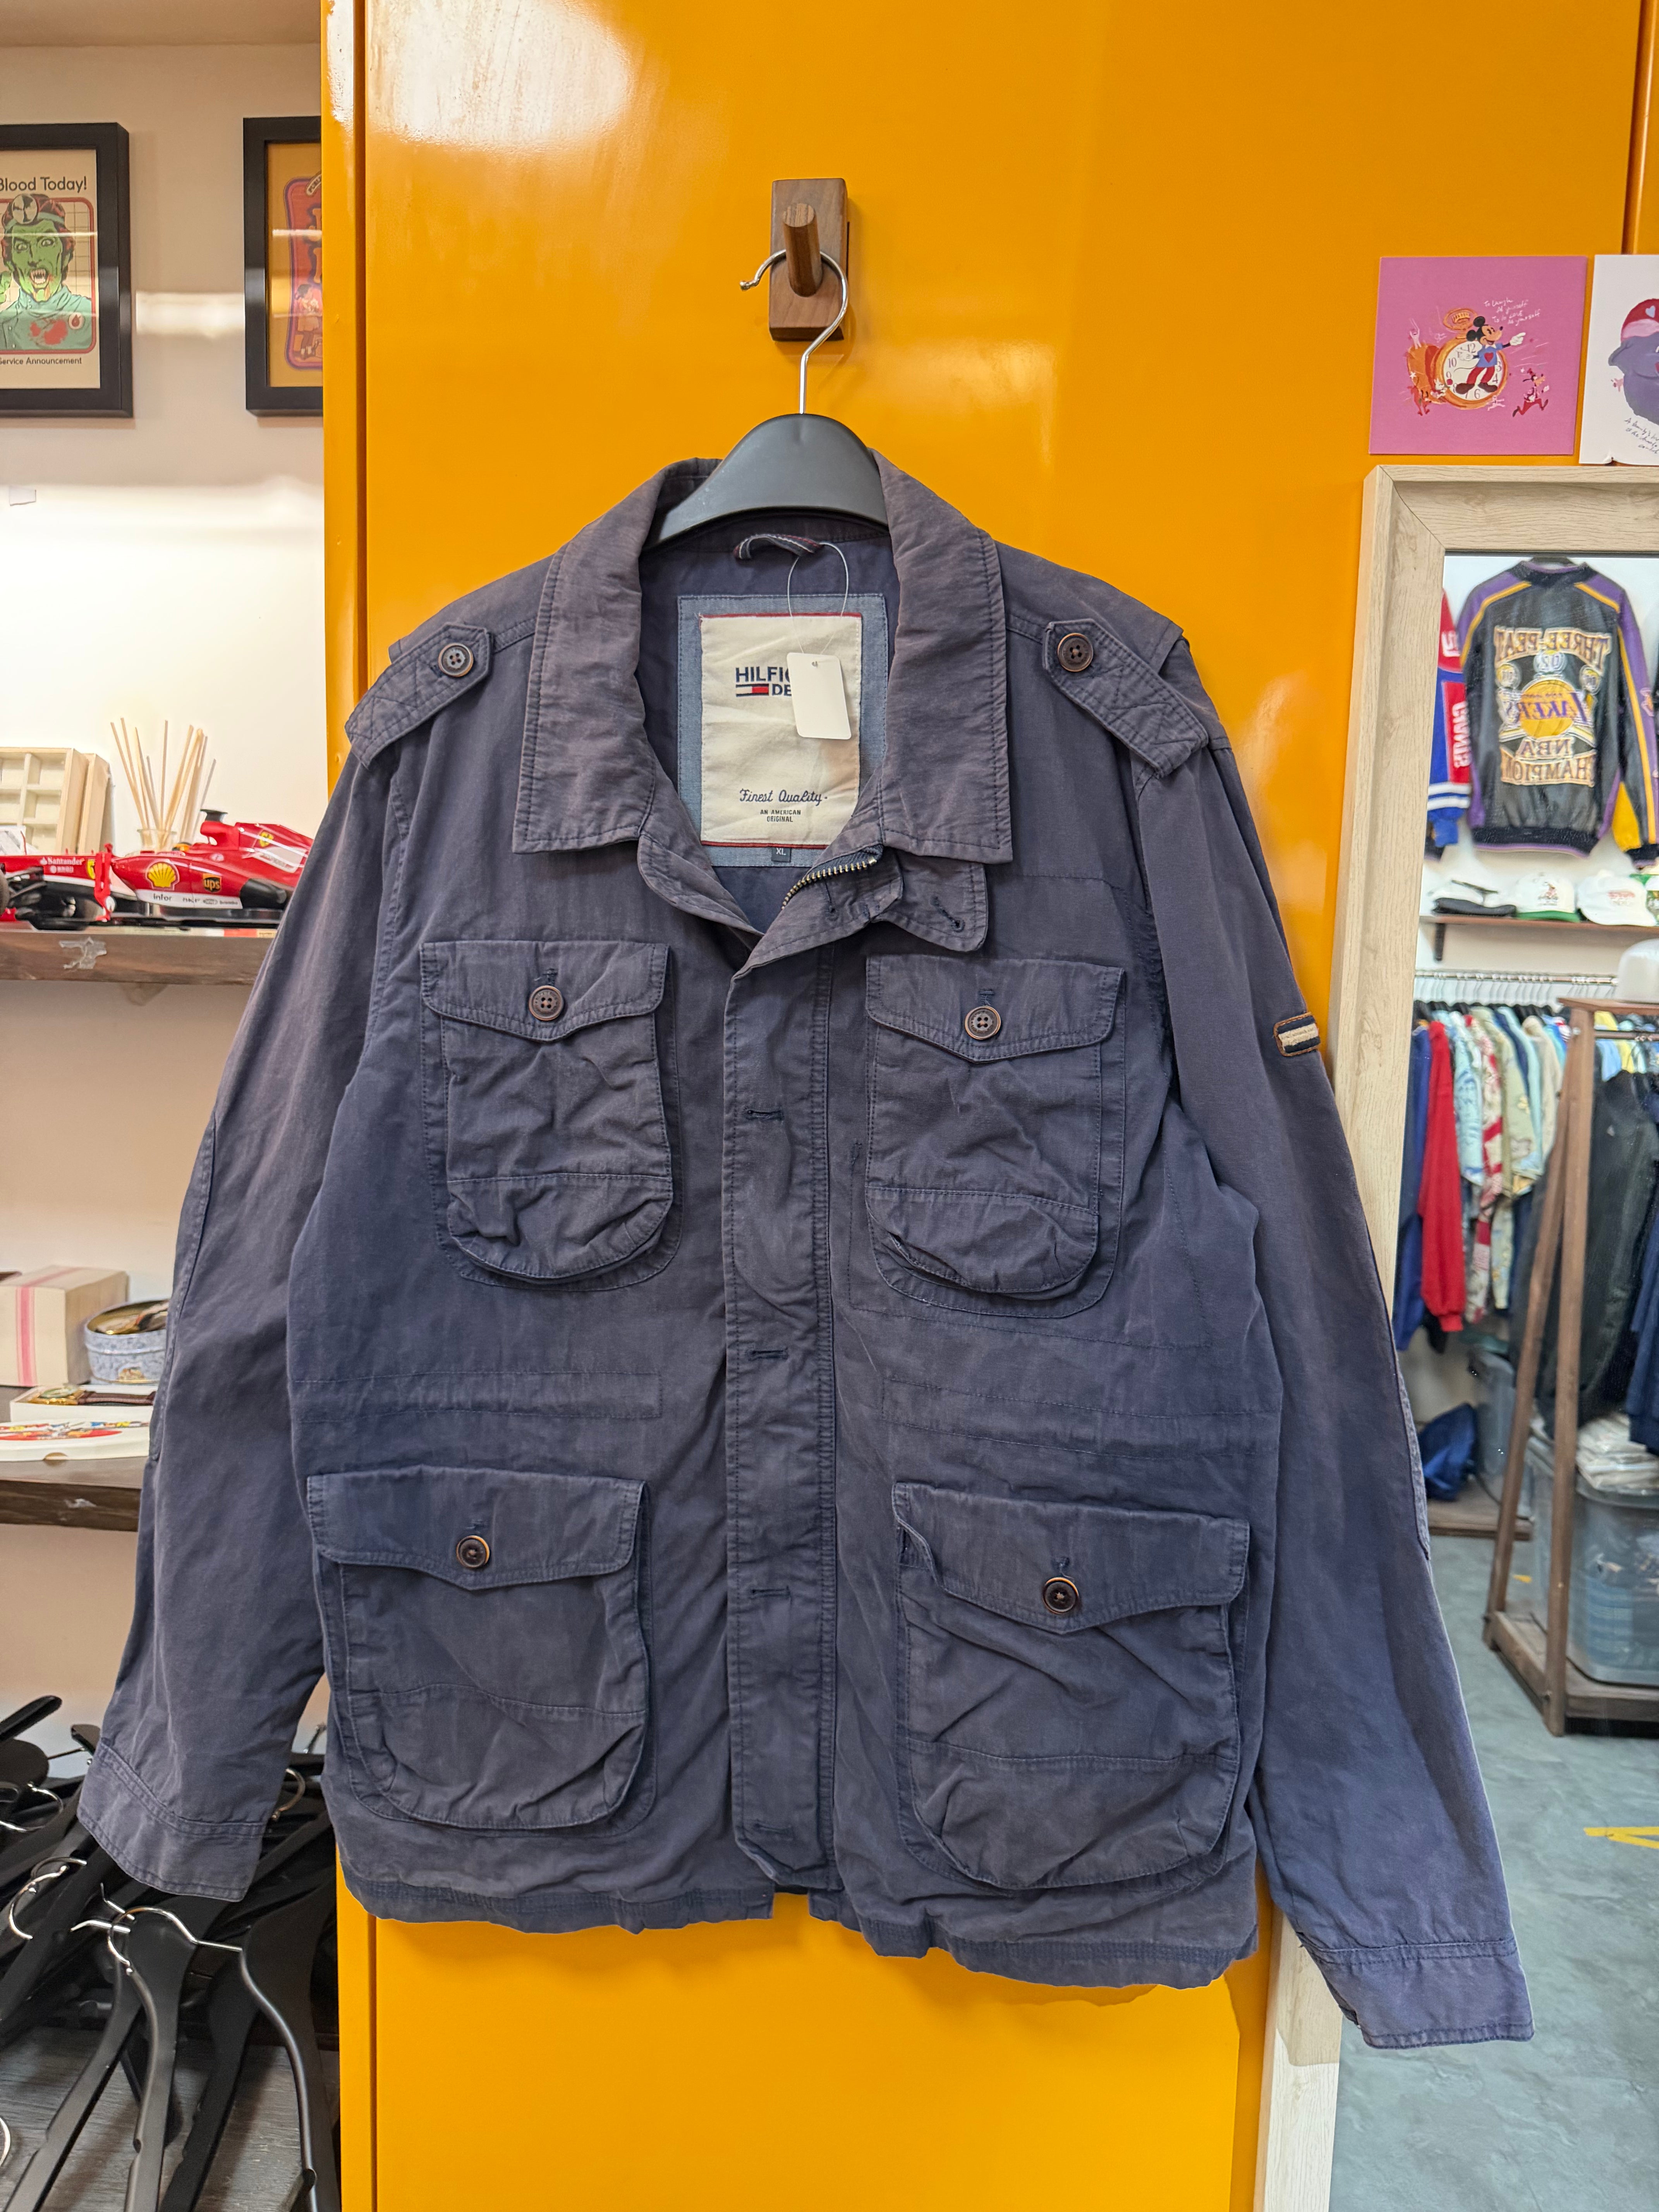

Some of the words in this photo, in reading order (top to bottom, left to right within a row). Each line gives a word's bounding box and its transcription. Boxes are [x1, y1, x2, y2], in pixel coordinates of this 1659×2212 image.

[40, 175, 87, 193] Today!
[26, 357, 82, 365] Announcement
[1448, 357, 1457, 368] 10
[1492, 373, 1498, 384] 4
[1474, 388, 1480, 399] 6
[735, 666, 790, 683] HILFI
[739, 788, 773, 802] Finest
[204, 879, 220, 892] ups
